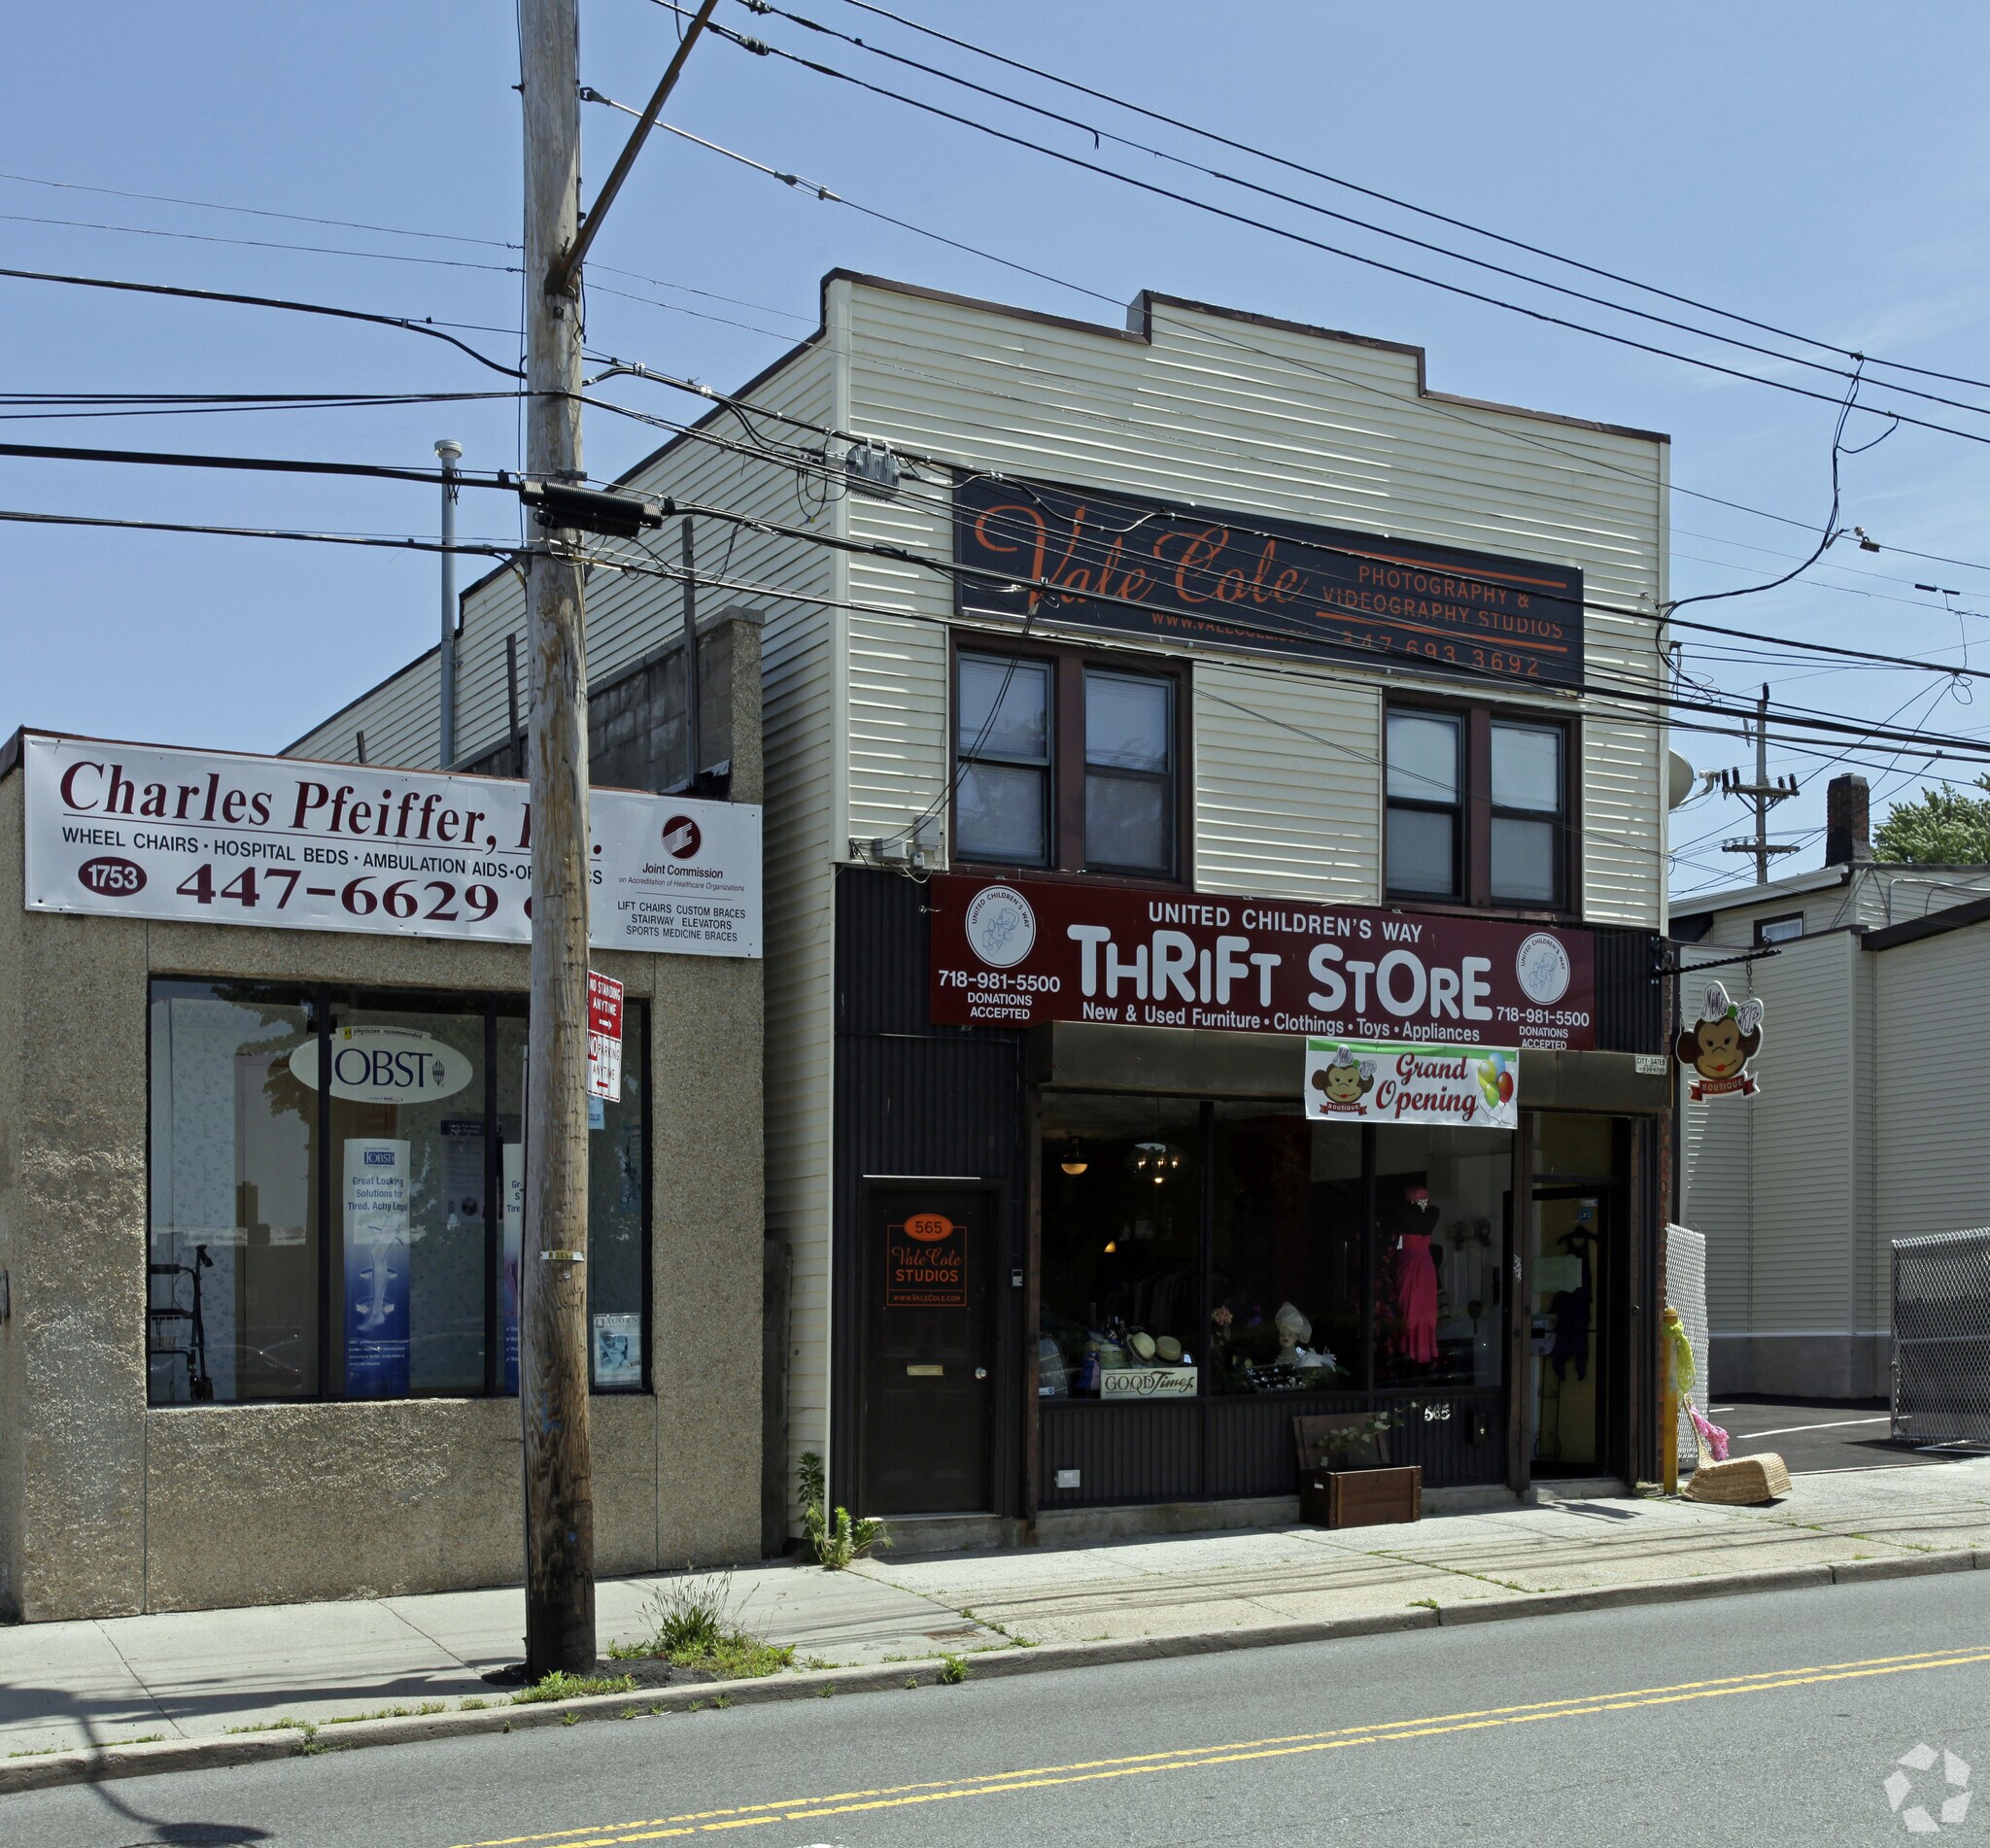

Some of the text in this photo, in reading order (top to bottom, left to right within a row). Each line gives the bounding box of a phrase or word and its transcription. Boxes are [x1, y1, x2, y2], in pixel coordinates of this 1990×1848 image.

[975, 504, 1309, 609] Vale Cole
[1358, 565, 1529, 609] PHOTOGRAPHY &
[1322, 586, 1563, 639] VIDEOGRAPHY STUDIOS
[1406, 639, 1457, 665] 693
[1472, 649, 1540, 677] 3692
[60, 760, 273, 827] Charles
[288, 780, 498, 856] Pfeiffer,
[62, 826, 126, 848] WHEEL
[133, 833, 199, 854] CHAIRS
[215, 839, 295, 863] HOSPITAL
[304, 846, 349, 867] BEDS
[363, 851, 466, 874] AMBULATION
[472, 860, 508, 879] AIDS
[87, 864, 138, 890] 1753
[642, 863, 723, 879] Joint Commission
[176, 862, 499, 924] 447-6629
[628, 876, 666, 886] Accreditation
[673, 880, 704, 889] Healthcare
[705, 881, 745, 892] Organizations
[617, 901, 746, 919] LIFT CHAIRS CUSTOM BRACES
[972, 891, 1030, 929] UNITED CHILDREN'S WAY
[632, 913, 733, 930] STAIRWAY ELEVATORS
[1149, 901, 1423, 943] UNITED CHILDREN'S WAY
[626, 925, 738, 942] SPORTS MEDICINE BRACES
[1521, 944, 1531, 967] UNITED
[589, 977, 621, 1002] NO STANDING
[938, 969, 1062, 994] 718-981-5500
[1307, 942, 1493, 1022] STORE
[593, 996, 617, 1016] ANYTIME
[967, 992, 1034, 1007] DONATIONS
[970, 1006, 1031, 1020] ACCEPTED
[1082, 1001, 1481, 1044] New & Used Furniture Clothings Toys Appliances
[1496, 1006, 1591, 1028] 718-981-5500
[1519, 1025, 1569, 1040] DONATIONS
[588, 1035, 620, 1062] NO PARKING
[1521, 1038, 1567, 1050] ACCEPTED
[327, 1047, 433, 1088] OBST
[593, 1063, 615, 1081] ANYTIME
[1395, 1050, 1470, 1085] Grand
[1701, 1078, 1744, 1091] BOUTIQUE
[1327, 1102, 1359, 1112] BOUTIQUE
[1374, 1077, 1480, 1122] Opening
[365, 1152, 393, 1164] JOBST
[352, 1176, 404, 1187] Great Looking
[356, 1188, 394, 1199] Solutions
[347, 1201, 370, 1212] Tired,
[371, 1202, 392, 1213] Achy
[914, 1220, 944, 1235] 565
[890, 1246, 963, 1267] Vale Cole
[895, 1268, 959, 1283] STUDIOS
[1104, 1370, 1195, 1394] GOOD Times
